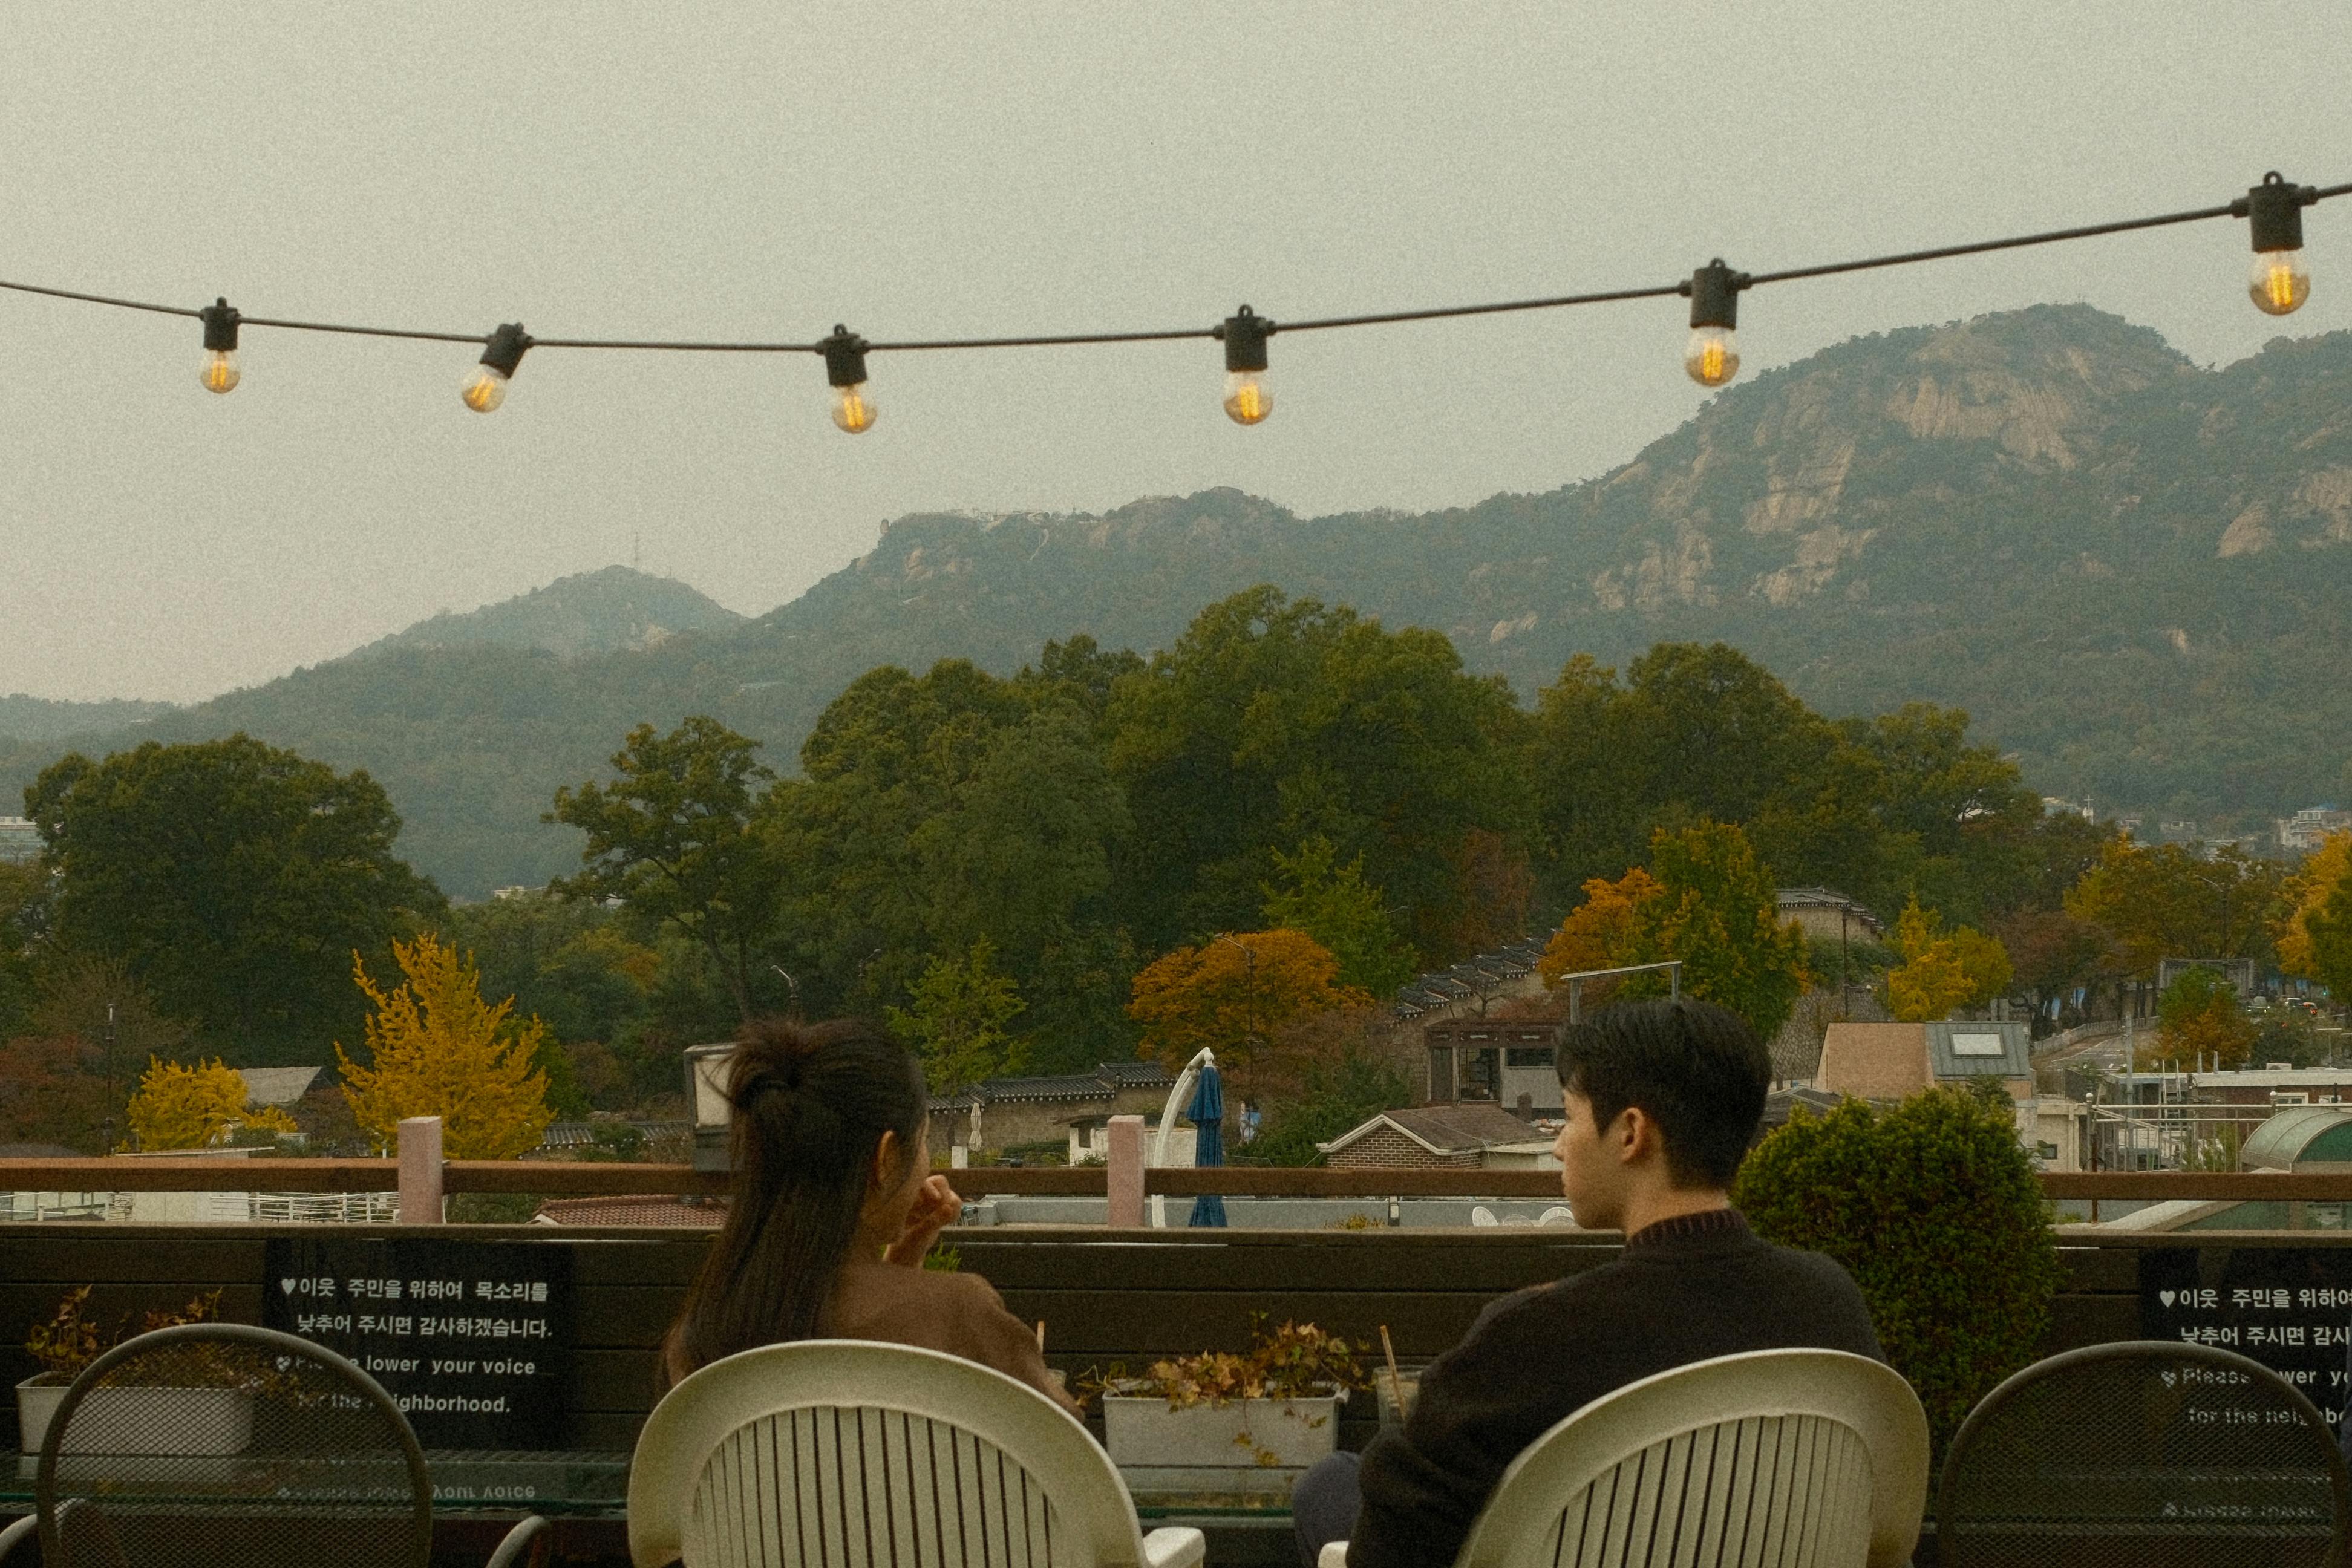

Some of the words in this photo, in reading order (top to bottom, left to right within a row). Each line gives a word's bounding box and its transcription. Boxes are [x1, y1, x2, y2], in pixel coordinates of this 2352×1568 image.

[299, 1278, 336, 1297] 이웃
[347, 1279, 403, 1298] 주민을
[409, 1279, 463, 1300] 위하여
[475, 1281, 548, 1302] 목소리를
[2180, 1289, 2219, 1308] 이웃
[2232, 1289, 2292, 1308] 주민을
[297, 1314, 351, 1333] 낮추어
[358, 1315, 413, 1334] 주시면
[420, 1316, 553, 1338] 감사하겠습니다.
[2180, 1326, 2238, 1346] 낮추어
[2246, 1327, 2305, 1345] 주시면
[366, 1354, 420, 1372] lower
[431, 1359, 475, 1374] your
[483, 1357, 535, 1374] voice
[2278, 1370, 2316, 1384] wer
